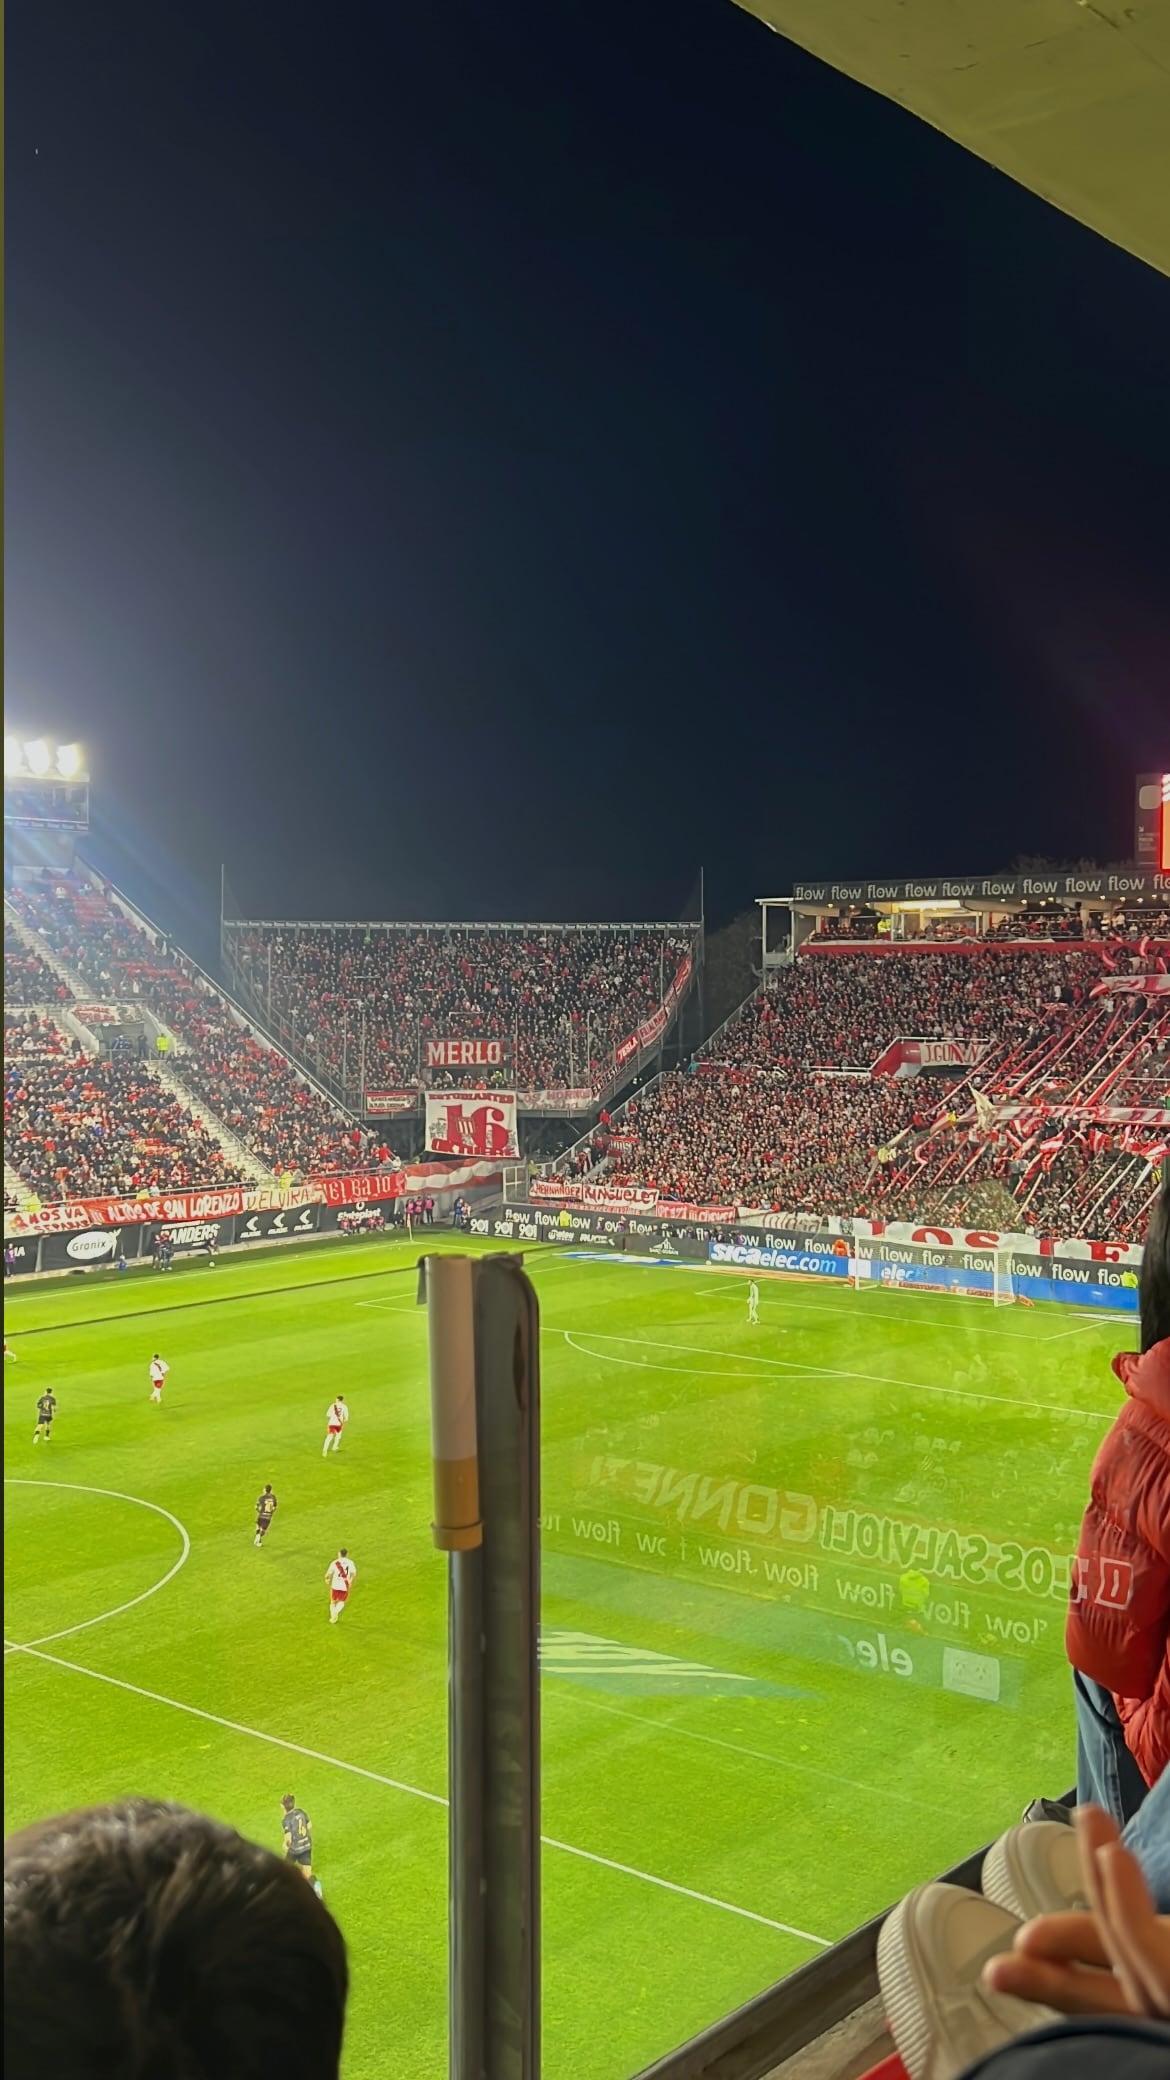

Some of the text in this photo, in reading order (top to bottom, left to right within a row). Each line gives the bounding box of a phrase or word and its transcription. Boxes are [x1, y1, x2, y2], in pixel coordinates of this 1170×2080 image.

[796, 874, 1170, 900] flow flow flow flow flow flow flow flow flow flo
[427, 1041, 501, 1066] MERLO
[107, 1203, 146, 1222] ALTOS
[144, 1200, 164, 1218] DE
[163, 1198, 188, 1219] SAN
[190, 1192, 240, 1217] LORENZO
[470, 1218, 489, 1233] 901
[494, 1221, 513, 1235] 901
[518, 1223, 537, 1238] 901
[72, 1240, 106, 1252] Granix
[535, 1211, 561, 1226] flow
[765, 1234, 796, 1251] flow
[805, 1240, 835, 1254] flow
[879, 1246, 913, 1264] flow
[1007, 1258, 1042, 1278] flow
[1052, 1264, 1089, 1283] flow
